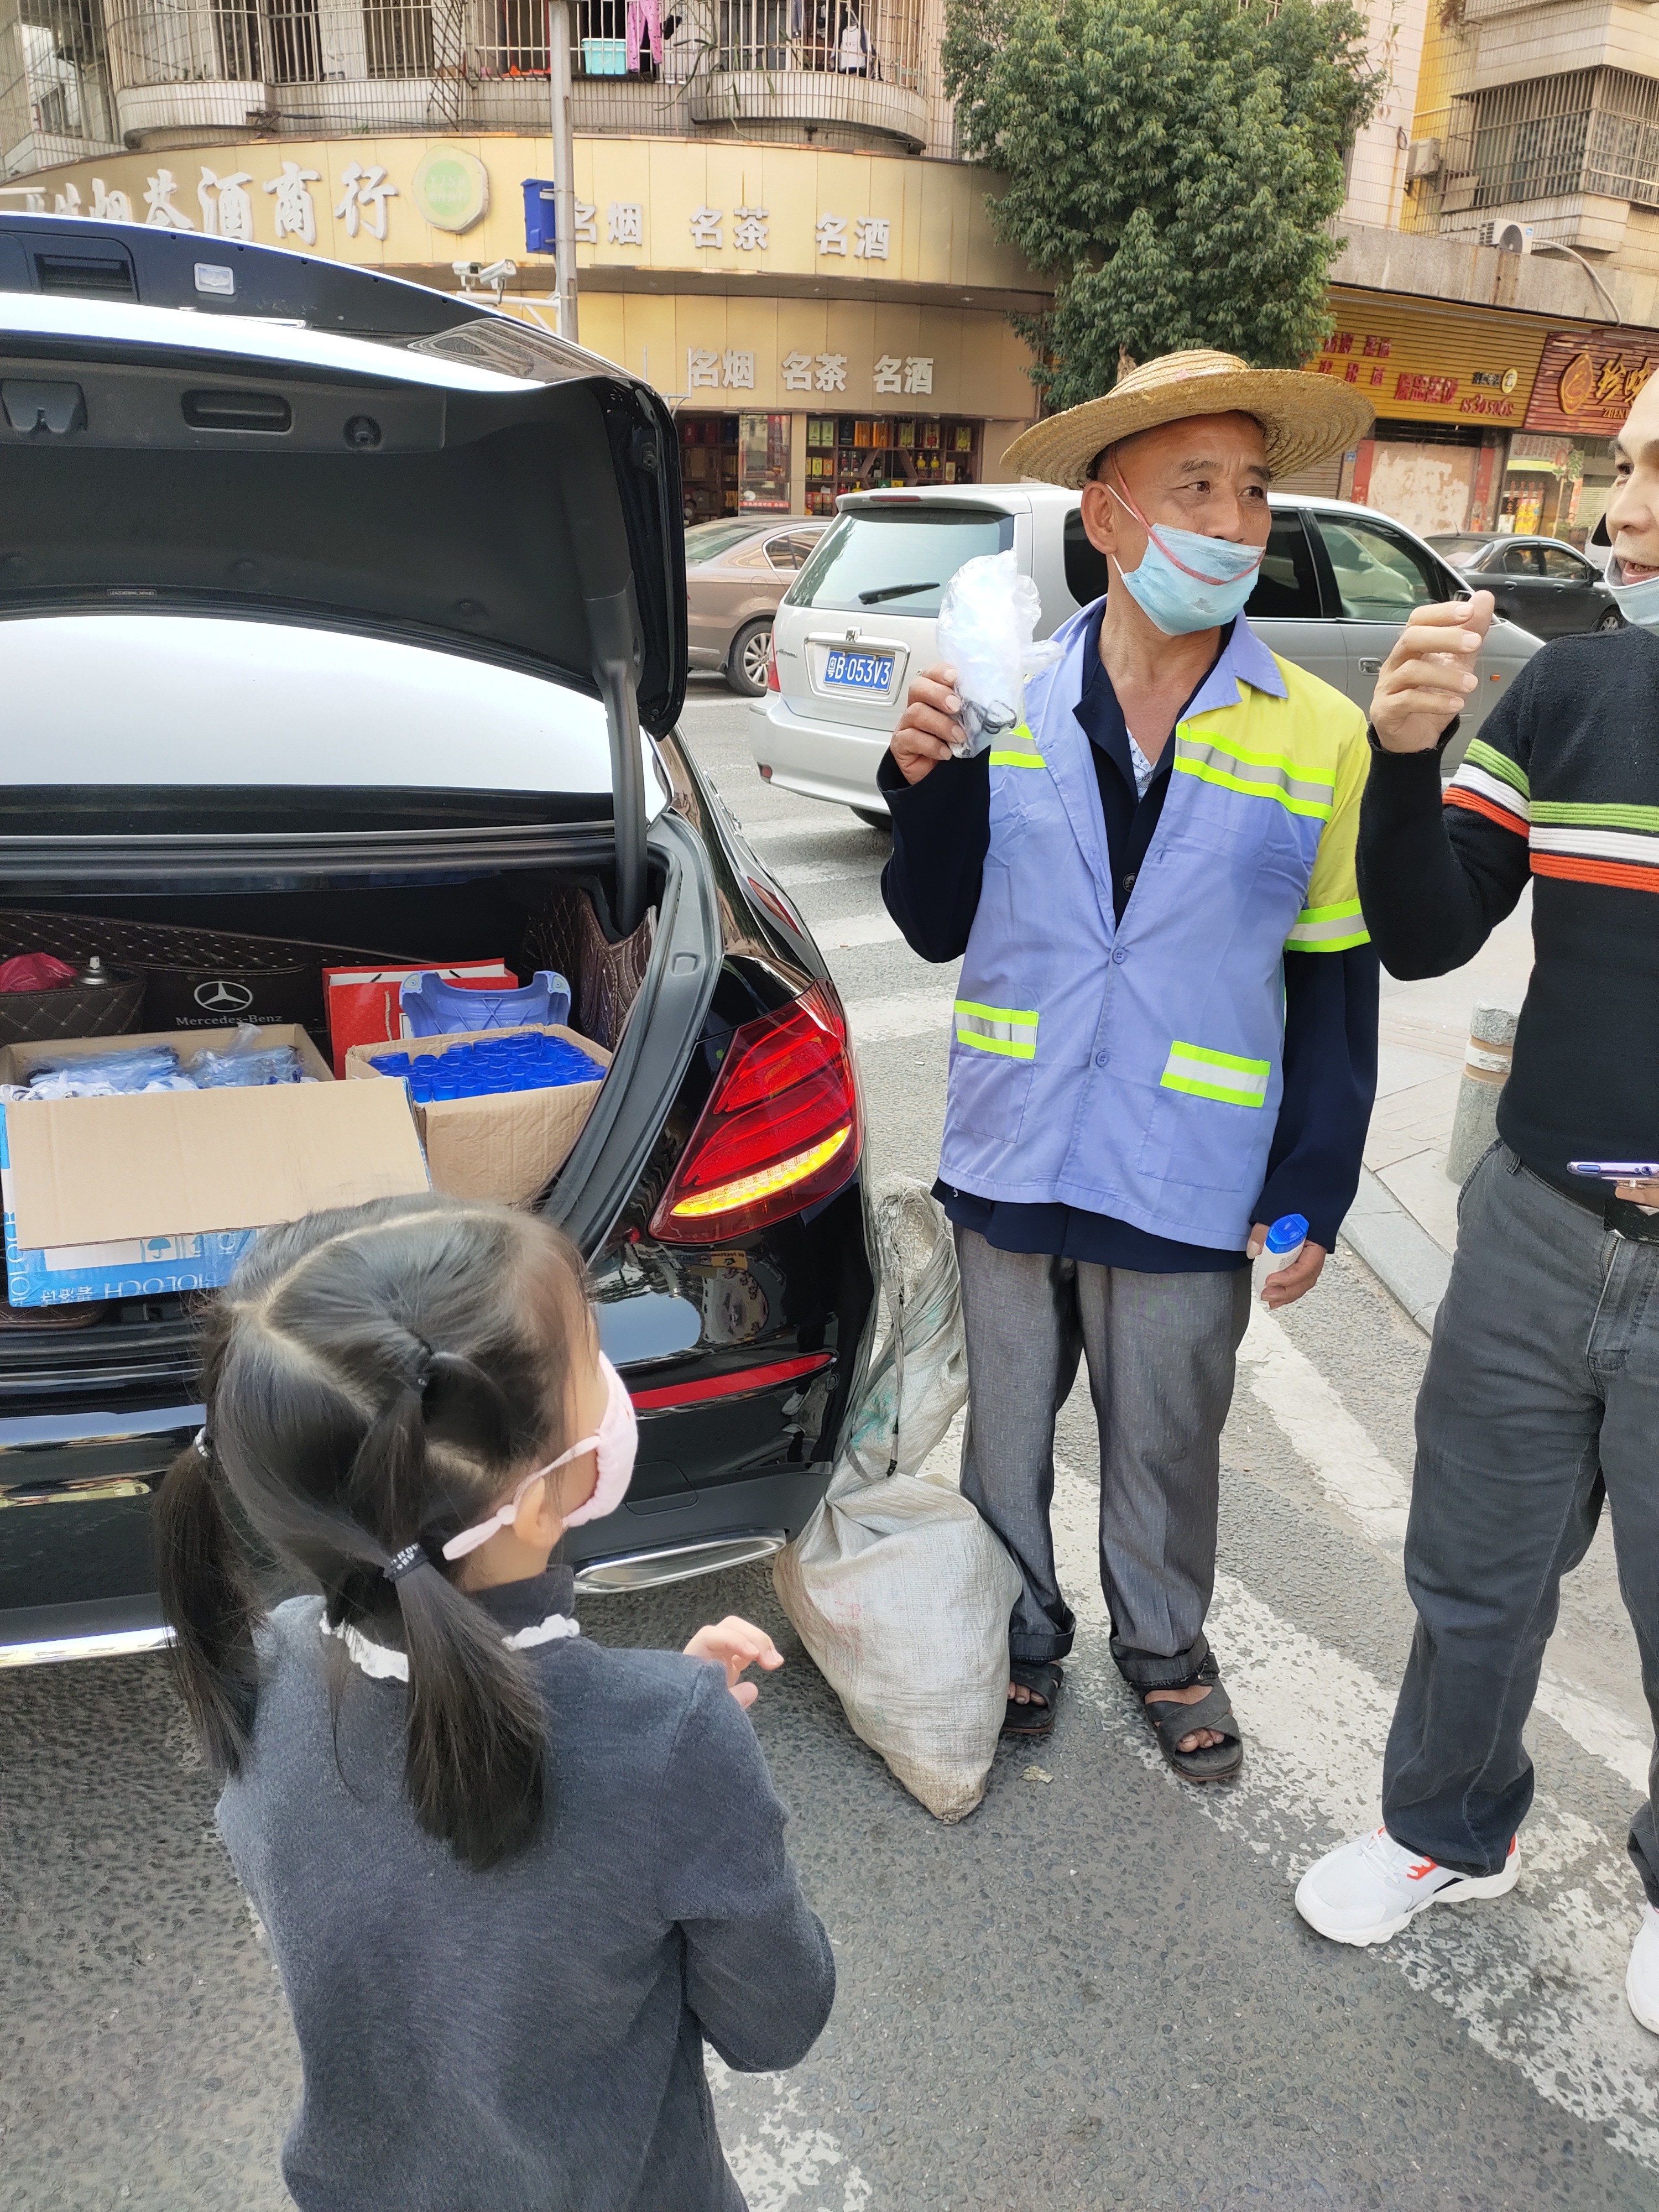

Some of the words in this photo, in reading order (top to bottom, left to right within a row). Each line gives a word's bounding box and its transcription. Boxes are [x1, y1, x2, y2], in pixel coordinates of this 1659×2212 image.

[575, 197, 643, 246] 名烟
[690, 205, 769, 251] 名茶
[815, 212, 890, 260] 名酒
[691, 348, 755, 388] 名烟
[782, 351, 848, 392] 名茶
[873, 354, 935, 394] 名酒
[175, 1014, 283, 1026] Mercedes-Benz
